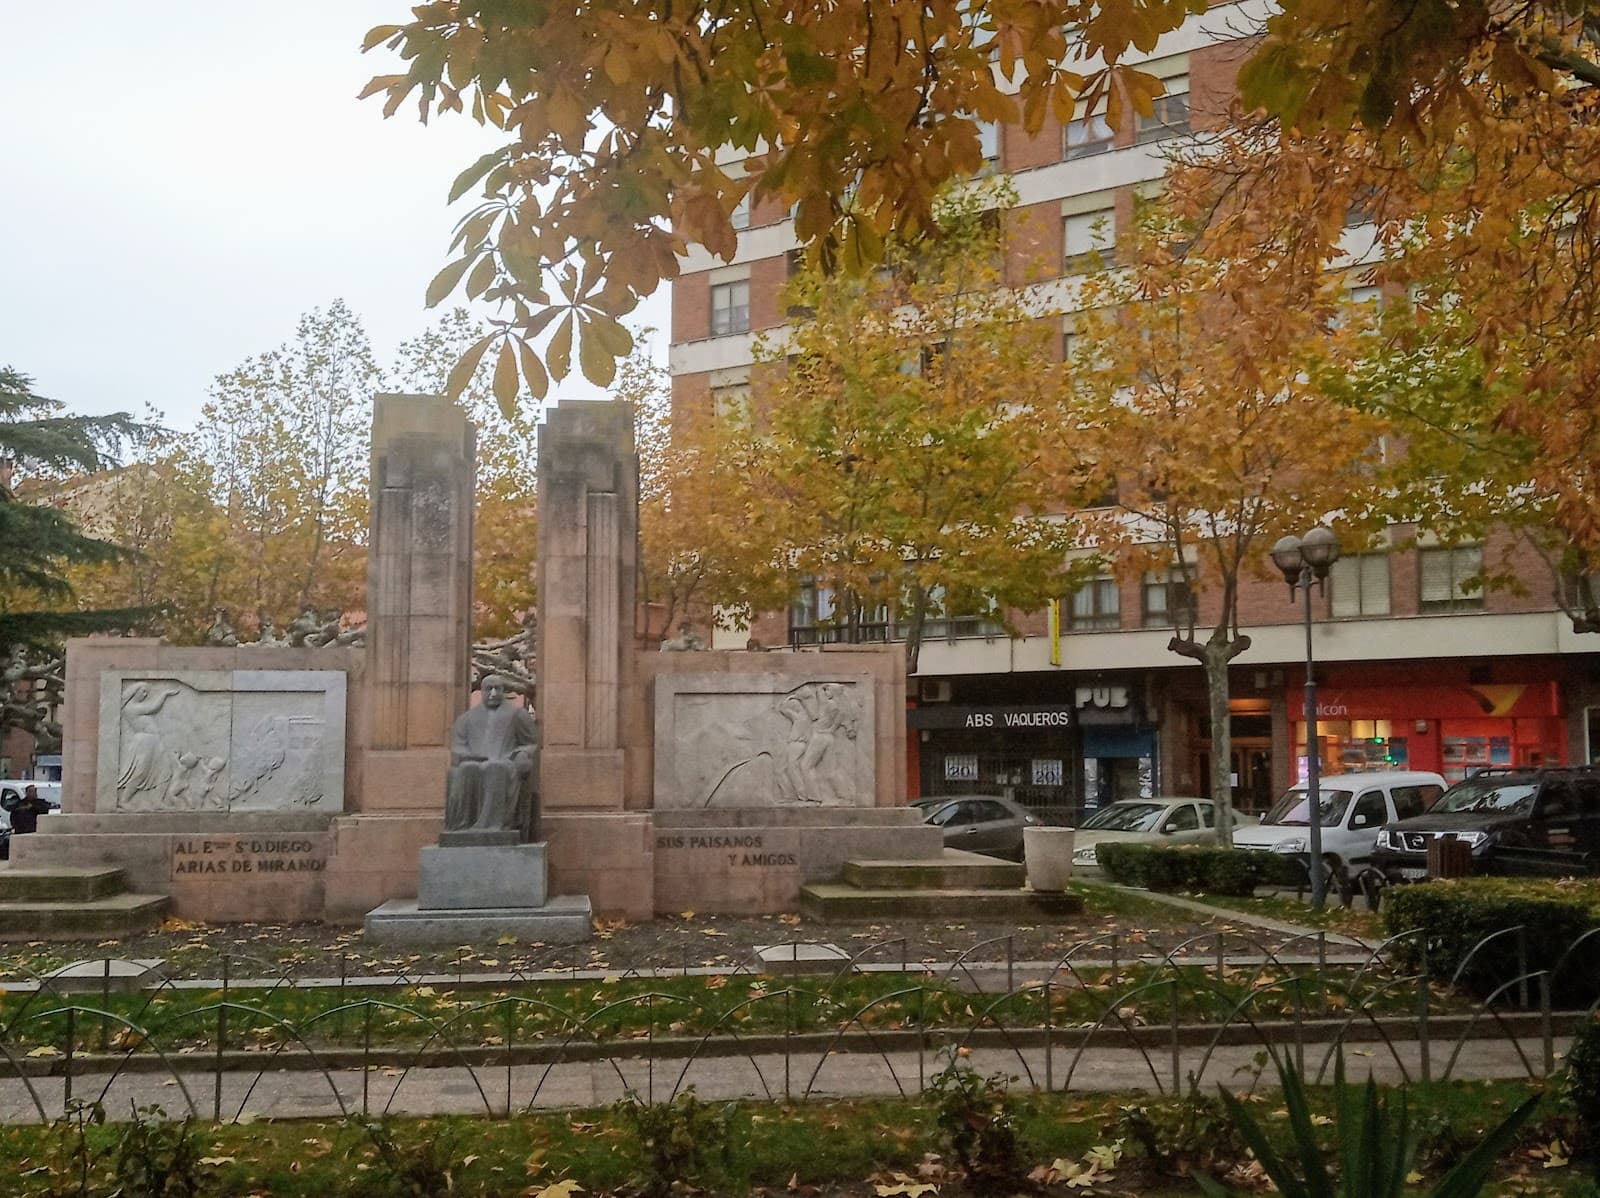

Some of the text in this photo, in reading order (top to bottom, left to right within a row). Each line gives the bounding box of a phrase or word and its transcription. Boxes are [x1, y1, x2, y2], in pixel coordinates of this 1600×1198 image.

[1075, 687, 1129, 709] PUB
[965, 711, 1069, 727] ABS VAQUEROS
[175, 842, 199, 855] AL
[690, 836, 762, 849] PAISANOS
[175, 860, 227, 874] ARIAS
[232, 860, 252, 873] DE
[728, 853, 797, 867] Y AMIGOS
